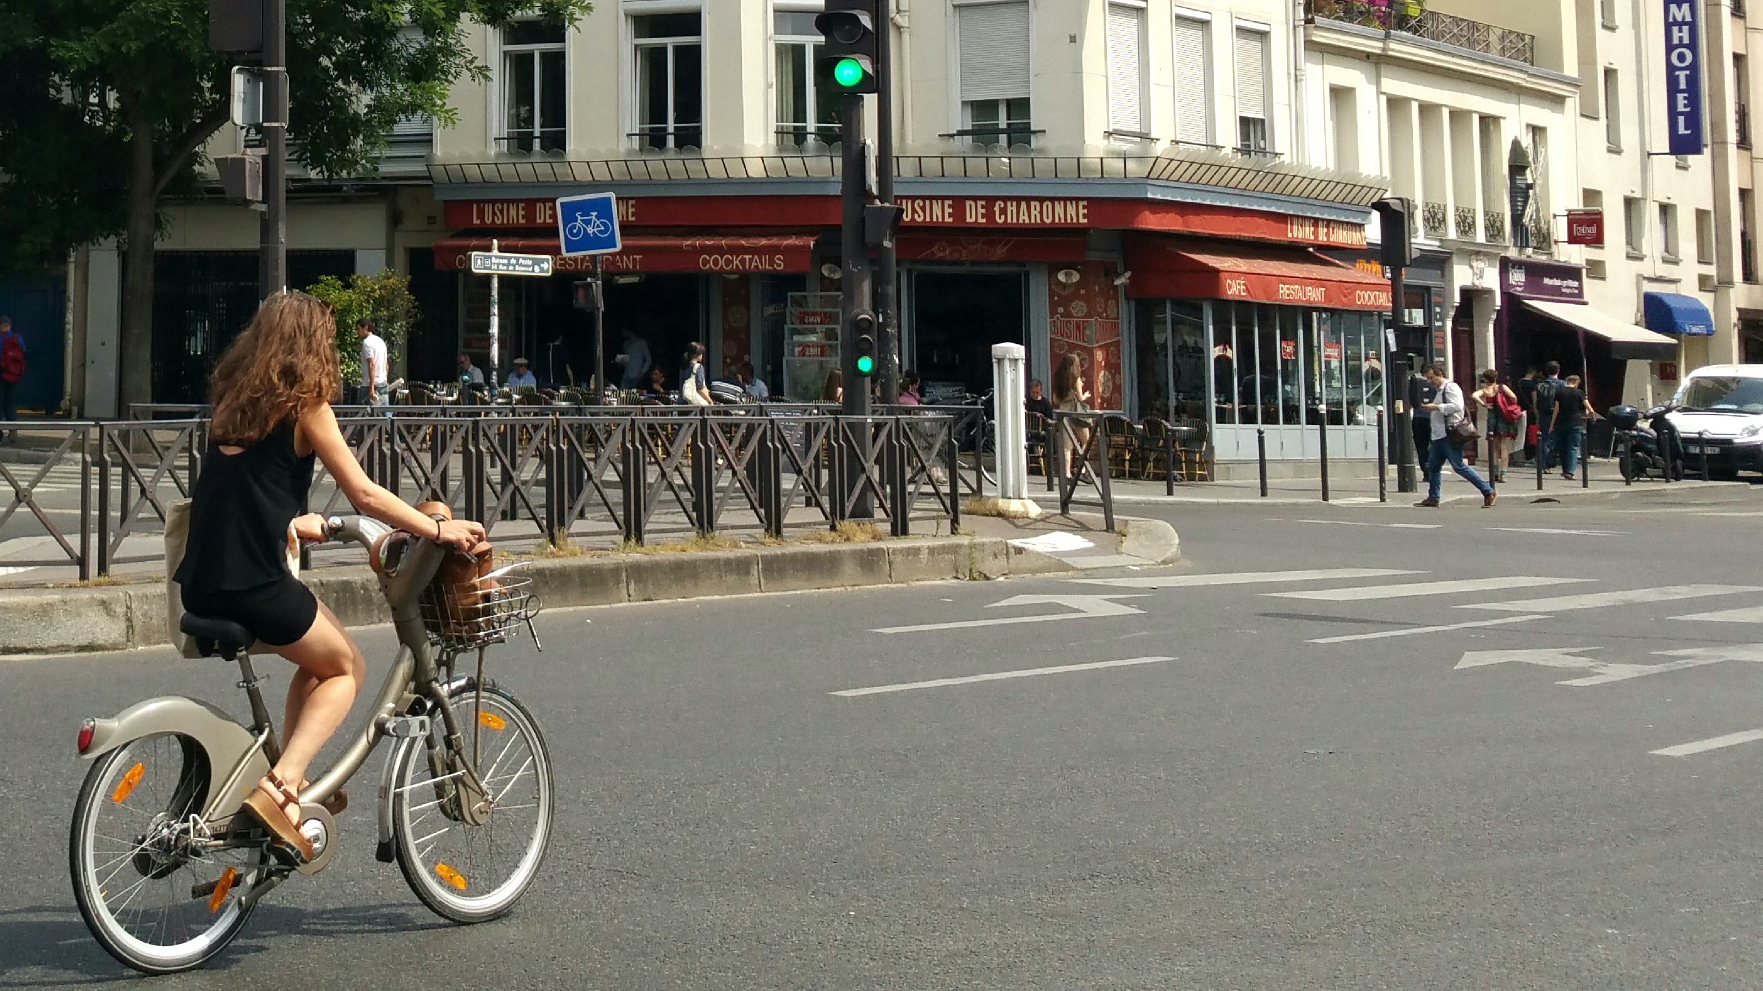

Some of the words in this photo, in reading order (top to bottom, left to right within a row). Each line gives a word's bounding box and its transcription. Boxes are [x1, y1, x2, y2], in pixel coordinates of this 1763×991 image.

[472, 202, 526, 225] L'USINE
[536, 202, 554, 224] DE
[897, 199, 953, 222] 'USINE
[965, 200, 987, 223] DE
[993, 200, 1088, 224] CHARONNE
[1287, 216, 1315, 240] L'USINE
[1318, 219, 1328, 242] DE
[1329, 222, 1367, 246] CHARONNE
[699, 254, 785, 271] COCKTAILS
[1226, 277, 1247, 296] CAFÉ
[1279, 283, 1326, 302] RESTAURANT
[1355, 290, 1392, 306] COCKTAILS
